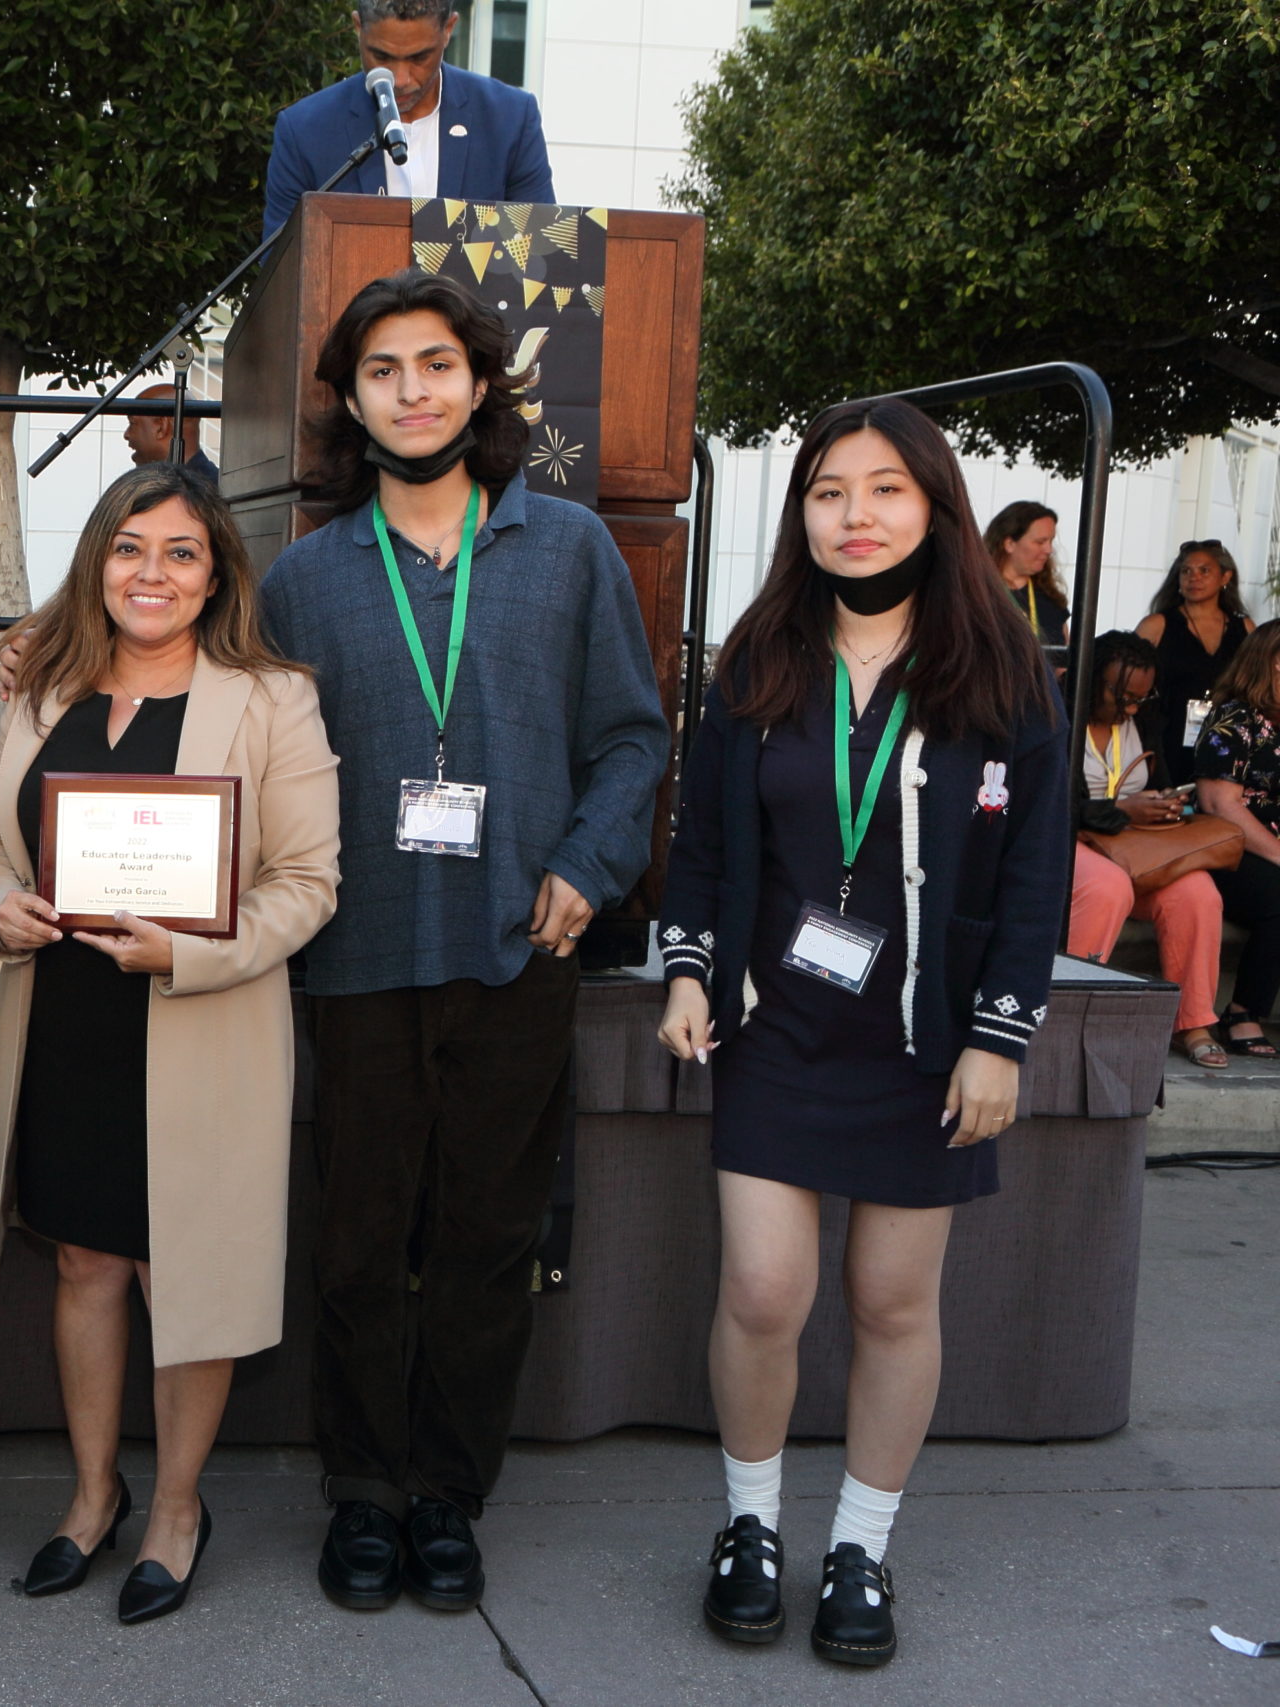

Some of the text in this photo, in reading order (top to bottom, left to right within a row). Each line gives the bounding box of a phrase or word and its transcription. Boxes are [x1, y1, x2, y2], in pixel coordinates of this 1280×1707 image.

[133, 810, 163, 825] IEL
[127, 837, 147, 845] 2022
[81, 850, 192, 862] Educator Leadership
[119, 863, 153, 871] Award
[104, 886, 132, 896] Leyda
